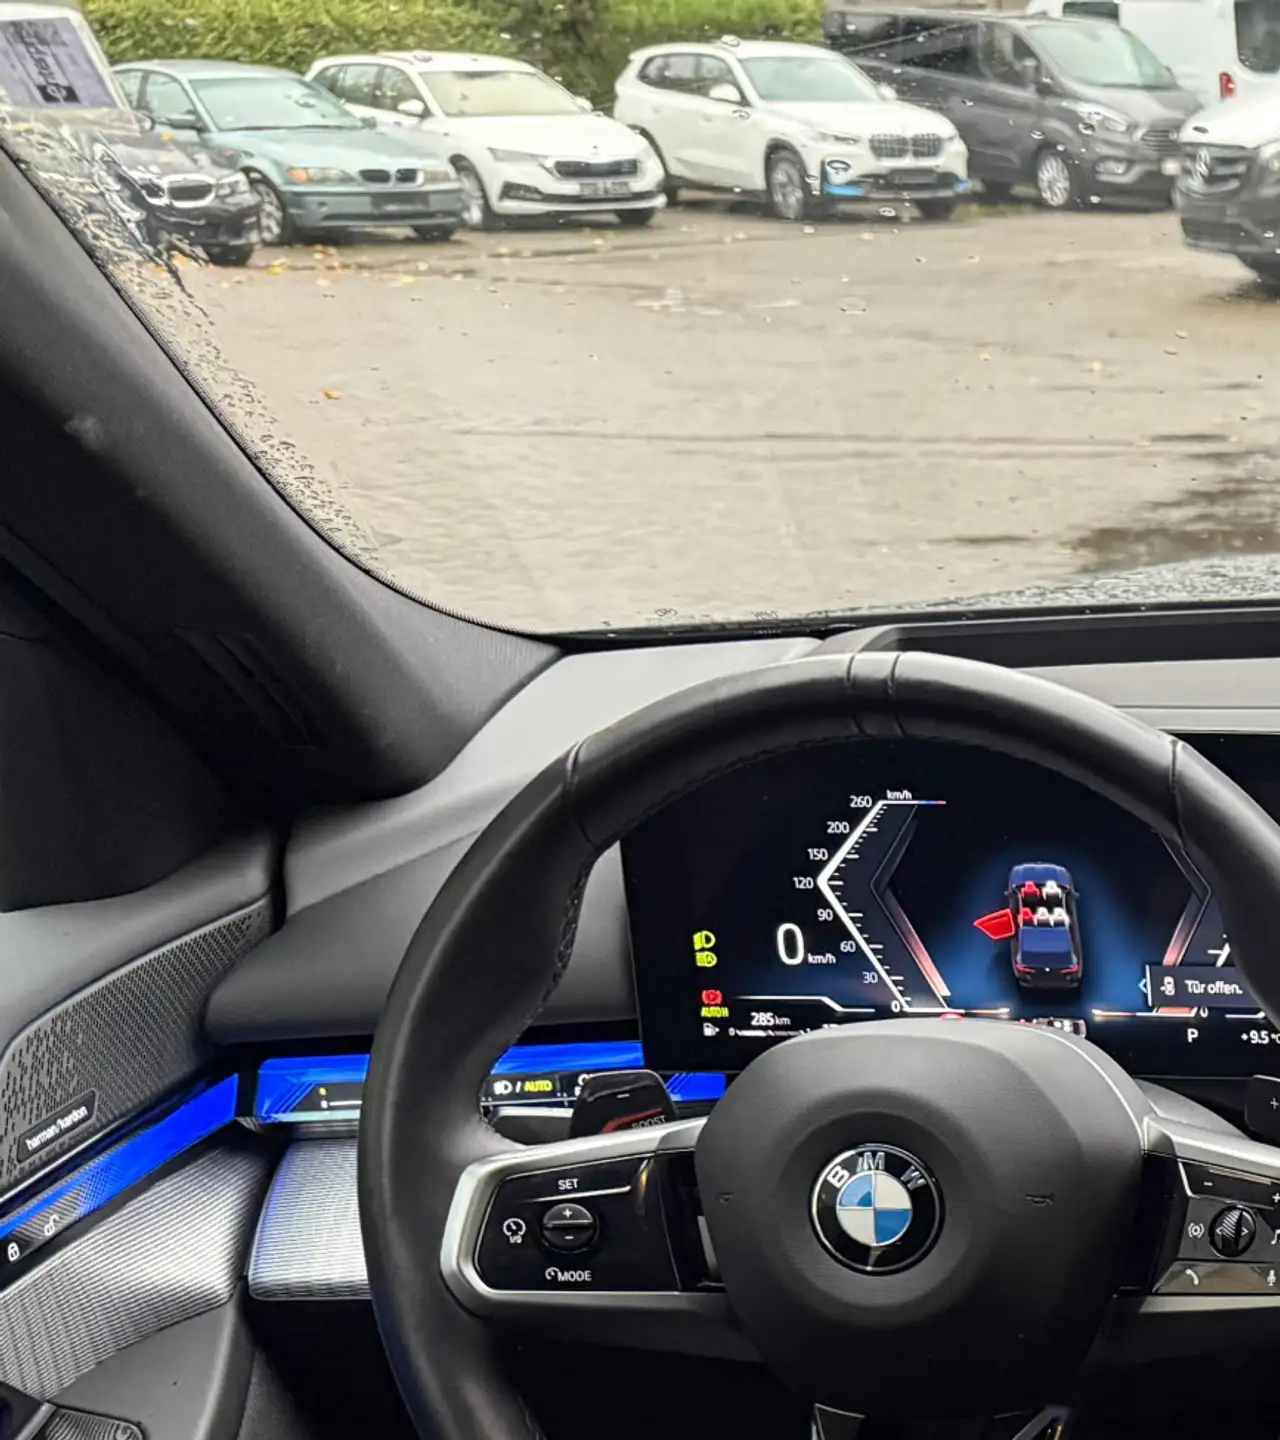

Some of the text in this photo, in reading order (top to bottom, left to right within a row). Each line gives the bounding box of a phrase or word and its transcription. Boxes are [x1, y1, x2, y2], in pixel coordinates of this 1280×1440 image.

[886, 789, 912, 800] km/h
[850, 795, 872, 808] 260
[827, 821, 849, 834] 200
[807, 849, 828, 861] 150
[793, 877, 814, 889] 120
[817, 909, 833, 921] 90
[776, 922, 836, 965] 0 km/h
[840, 940, 856, 953] 60
[862, 972, 878, 984] 30
[1184, 979, 1243, 995] Tür offen.
[890, 1000, 900, 1012] 0
[750, 1012, 791, 1026] 285 km
[1187, 1029, 1199, 1043] P
[524, 1079, 553, 1092] AUTO
[25, 1105, 89, 1151] harman/kardon
[826, 1150, 928, 1192] BMW
[558, 1178, 579, 1190] SET
[558, 1270, 592, 1282] MODE
